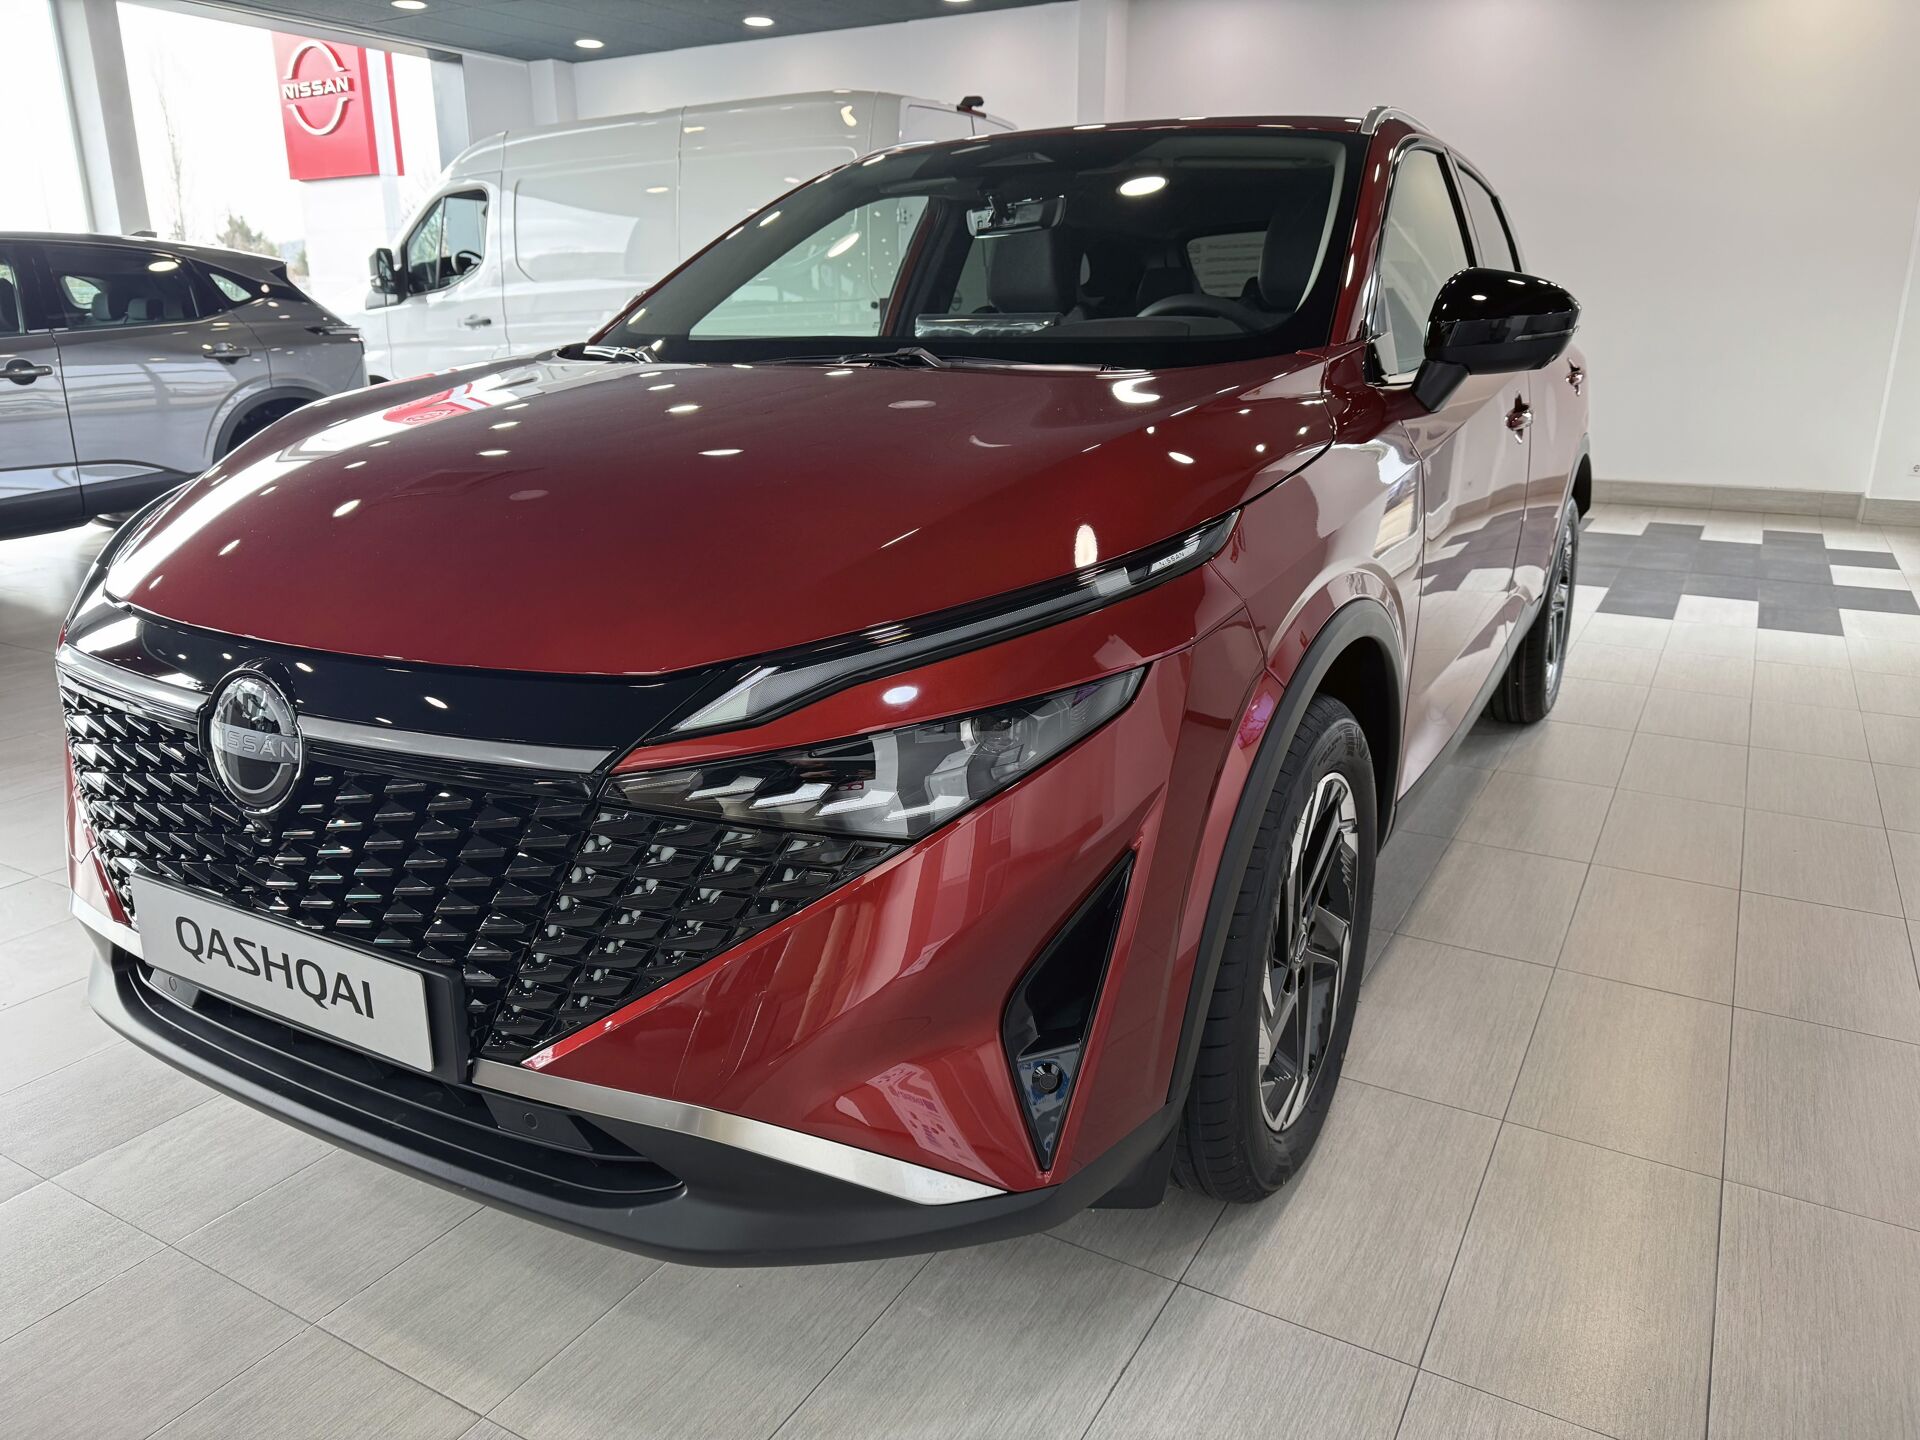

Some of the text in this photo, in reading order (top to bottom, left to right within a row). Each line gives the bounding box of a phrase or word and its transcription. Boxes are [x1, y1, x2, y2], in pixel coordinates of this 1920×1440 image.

[283, 76, 349, 100] NISSAN
[1159, 552, 1185, 566] NISSAN
[215, 727, 299, 761] SSAN
[176, 916, 374, 1019] QASHQAI
